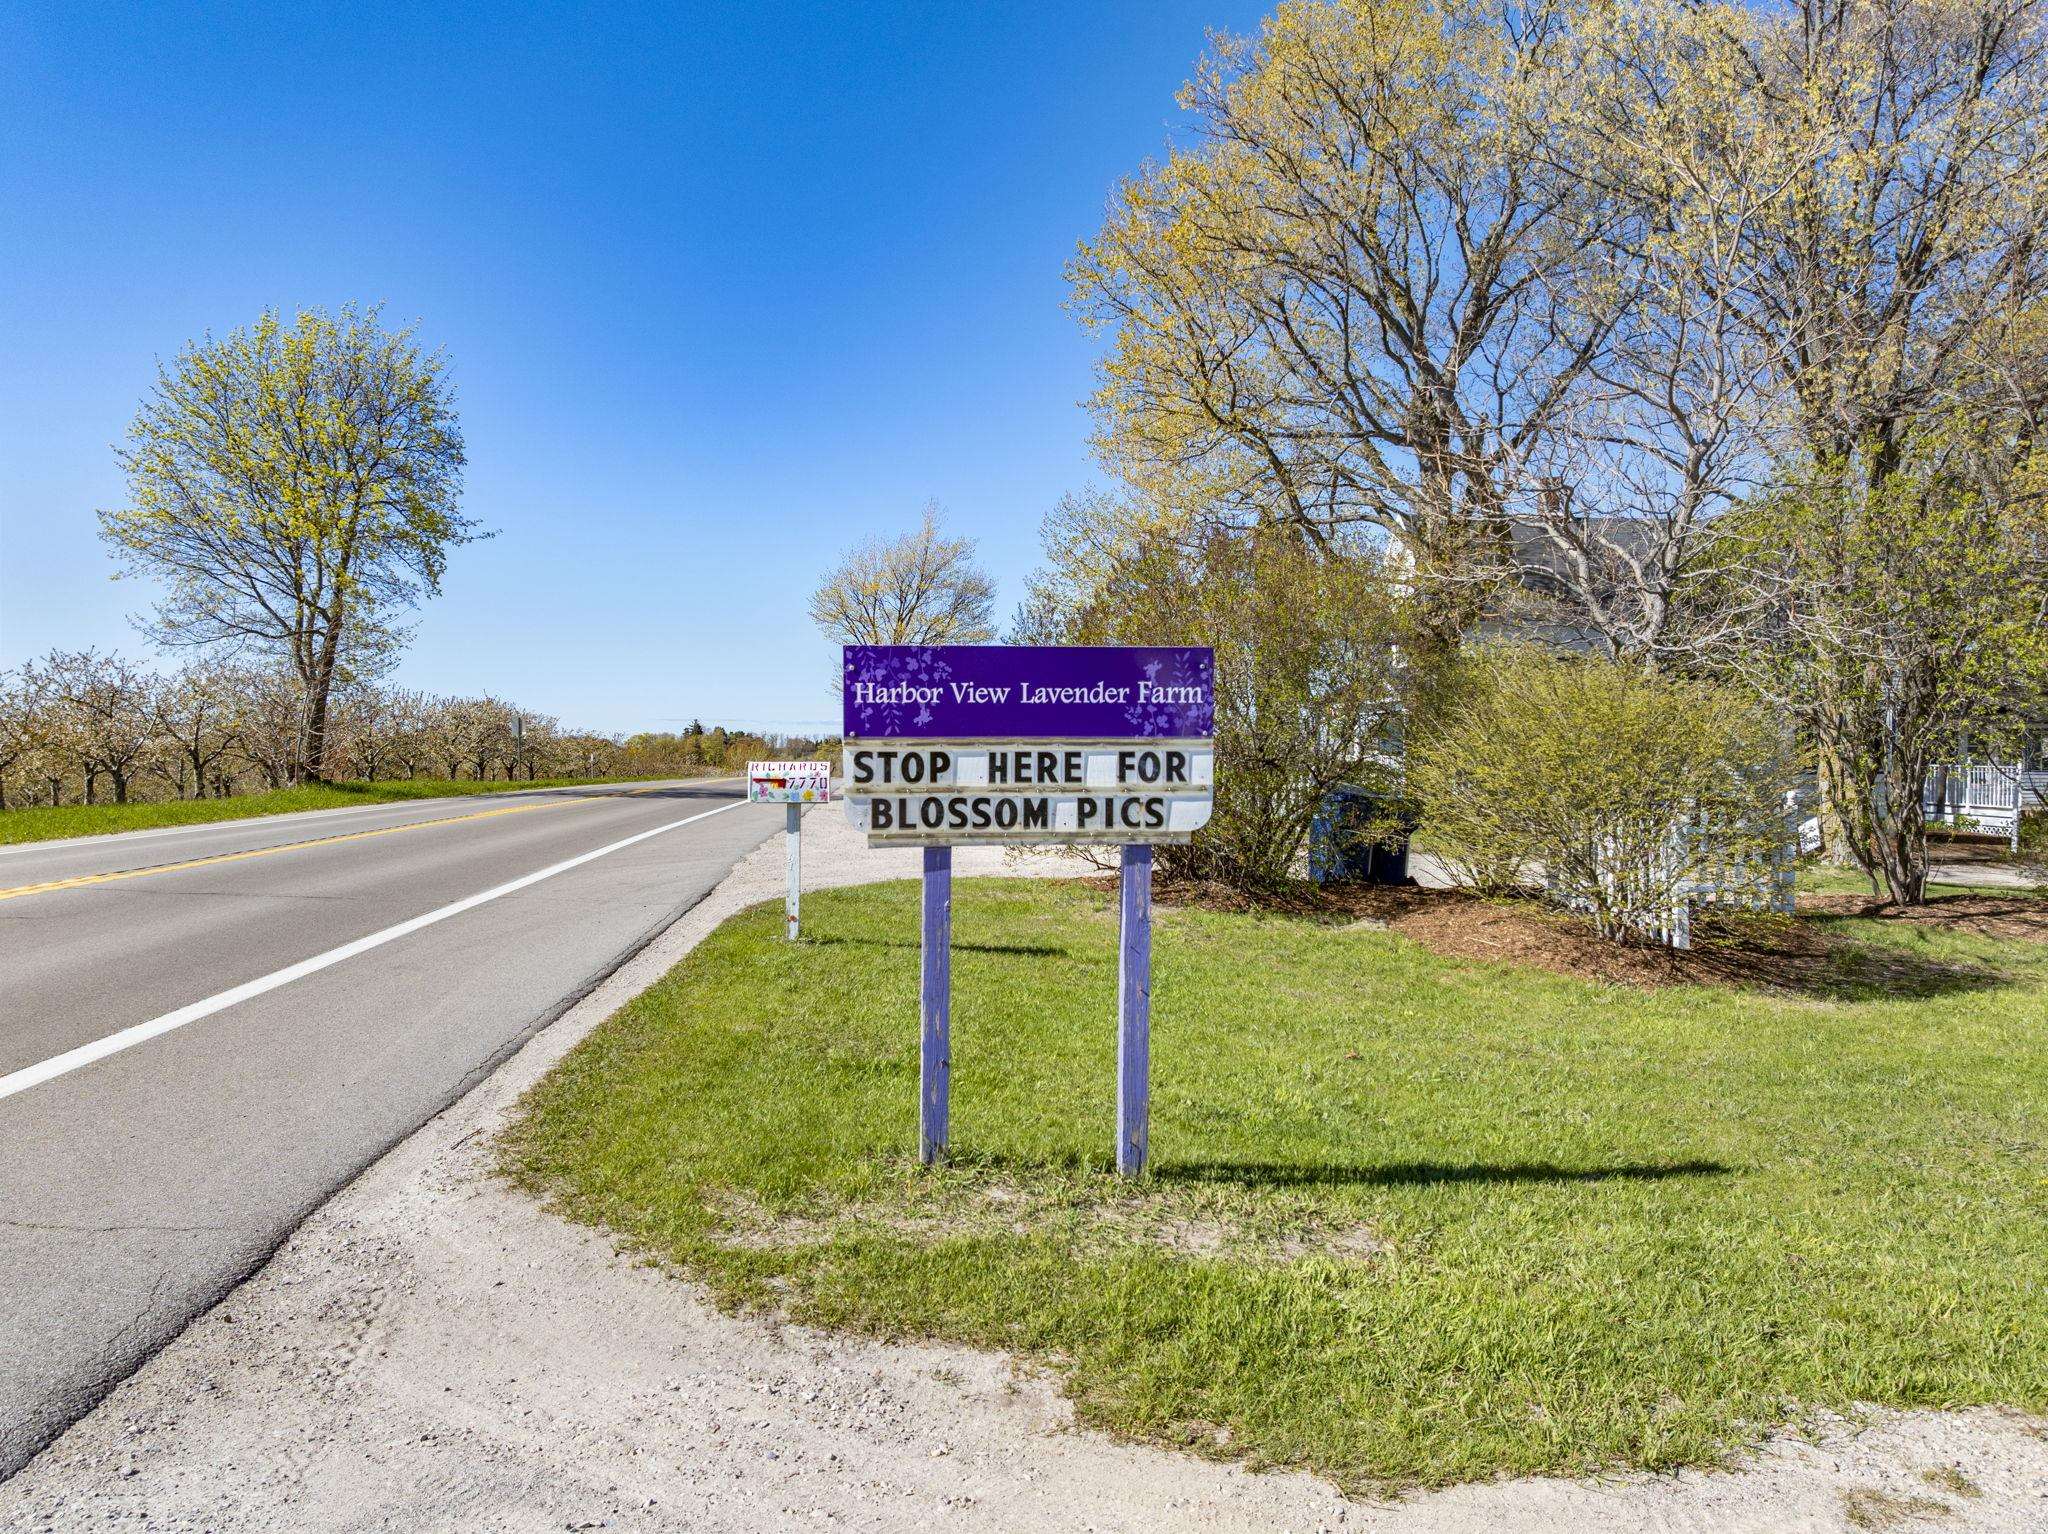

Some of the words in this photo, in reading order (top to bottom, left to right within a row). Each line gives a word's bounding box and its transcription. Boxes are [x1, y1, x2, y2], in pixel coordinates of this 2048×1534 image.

[854, 682, 943, 704] Harbor
[950, 682, 1011, 704] View
[1020, 681, 1130, 704] Lavender
[1137, 681, 1203, 703] Farm
[751, 762, 828, 772] RICHARDS
[853, 751, 950, 784] STOP
[988, 751, 1083, 783] HERE
[1117, 751, 1187, 783] FOR
[788, 777, 828, 789] 7770
[871, 797, 1049, 830] BLOSSOM
[1077, 797, 1165, 829] PICS
